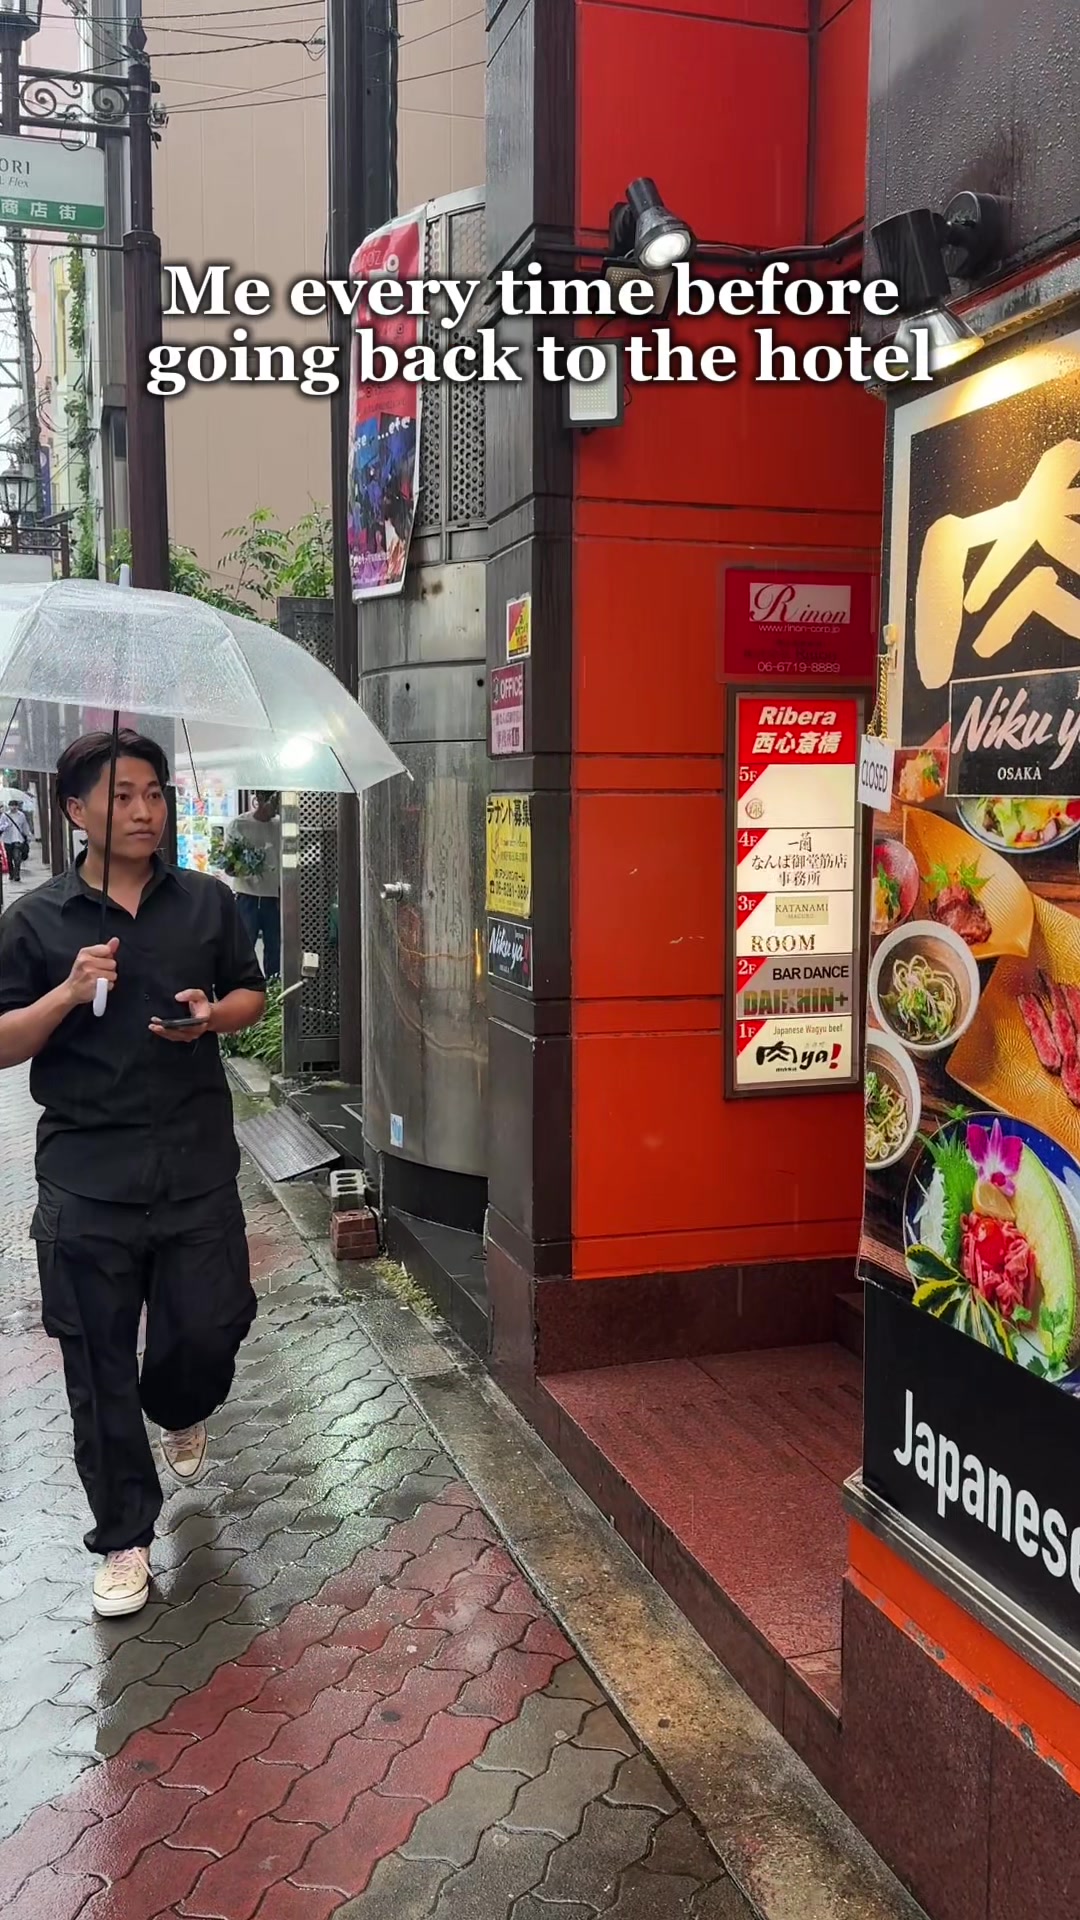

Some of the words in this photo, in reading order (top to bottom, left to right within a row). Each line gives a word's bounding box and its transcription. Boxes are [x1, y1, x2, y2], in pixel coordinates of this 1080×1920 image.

[8, 176, 29, 188] Flex
[1, 200, 77, 221] 商店街
[749, 583, 846, 622] Rinon
[758, 623, 841, 634] www.rinon-corp.jp
[757, 661, 841, 673] 06-6719-8889
[500, 675, 523, 700] OFFICE
[758, 706, 837, 726] Ribera
[951, 686, 1053, 754] Niku
[1049, 708, 1080, 770] y
[739, 766, 758, 782] 5F
[861, 759, 888, 793] CLOSED
[997, 766, 1042, 781] OSAKA
[738, 831, 758, 847] 4F
[751, 853, 848, 871] なんば御堂筋店
[779, 870, 821, 887] 事務所
[737, 896, 757, 911] 3F
[775, 903, 829, 913] KATANAMI
[489, 925, 511, 958] Niku
[751, 934, 816, 952] ROOM
[738, 960, 757, 975] 2F
[772, 967, 802, 980] BAR
[803, 965, 849, 979] DANCE
[738, 1023, 755, 1038] 1F
[773, 1026, 804, 1036] Japanese
[805, 1024, 828, 1035] Wagyu
[828, 1024, 843, 1033] beef
